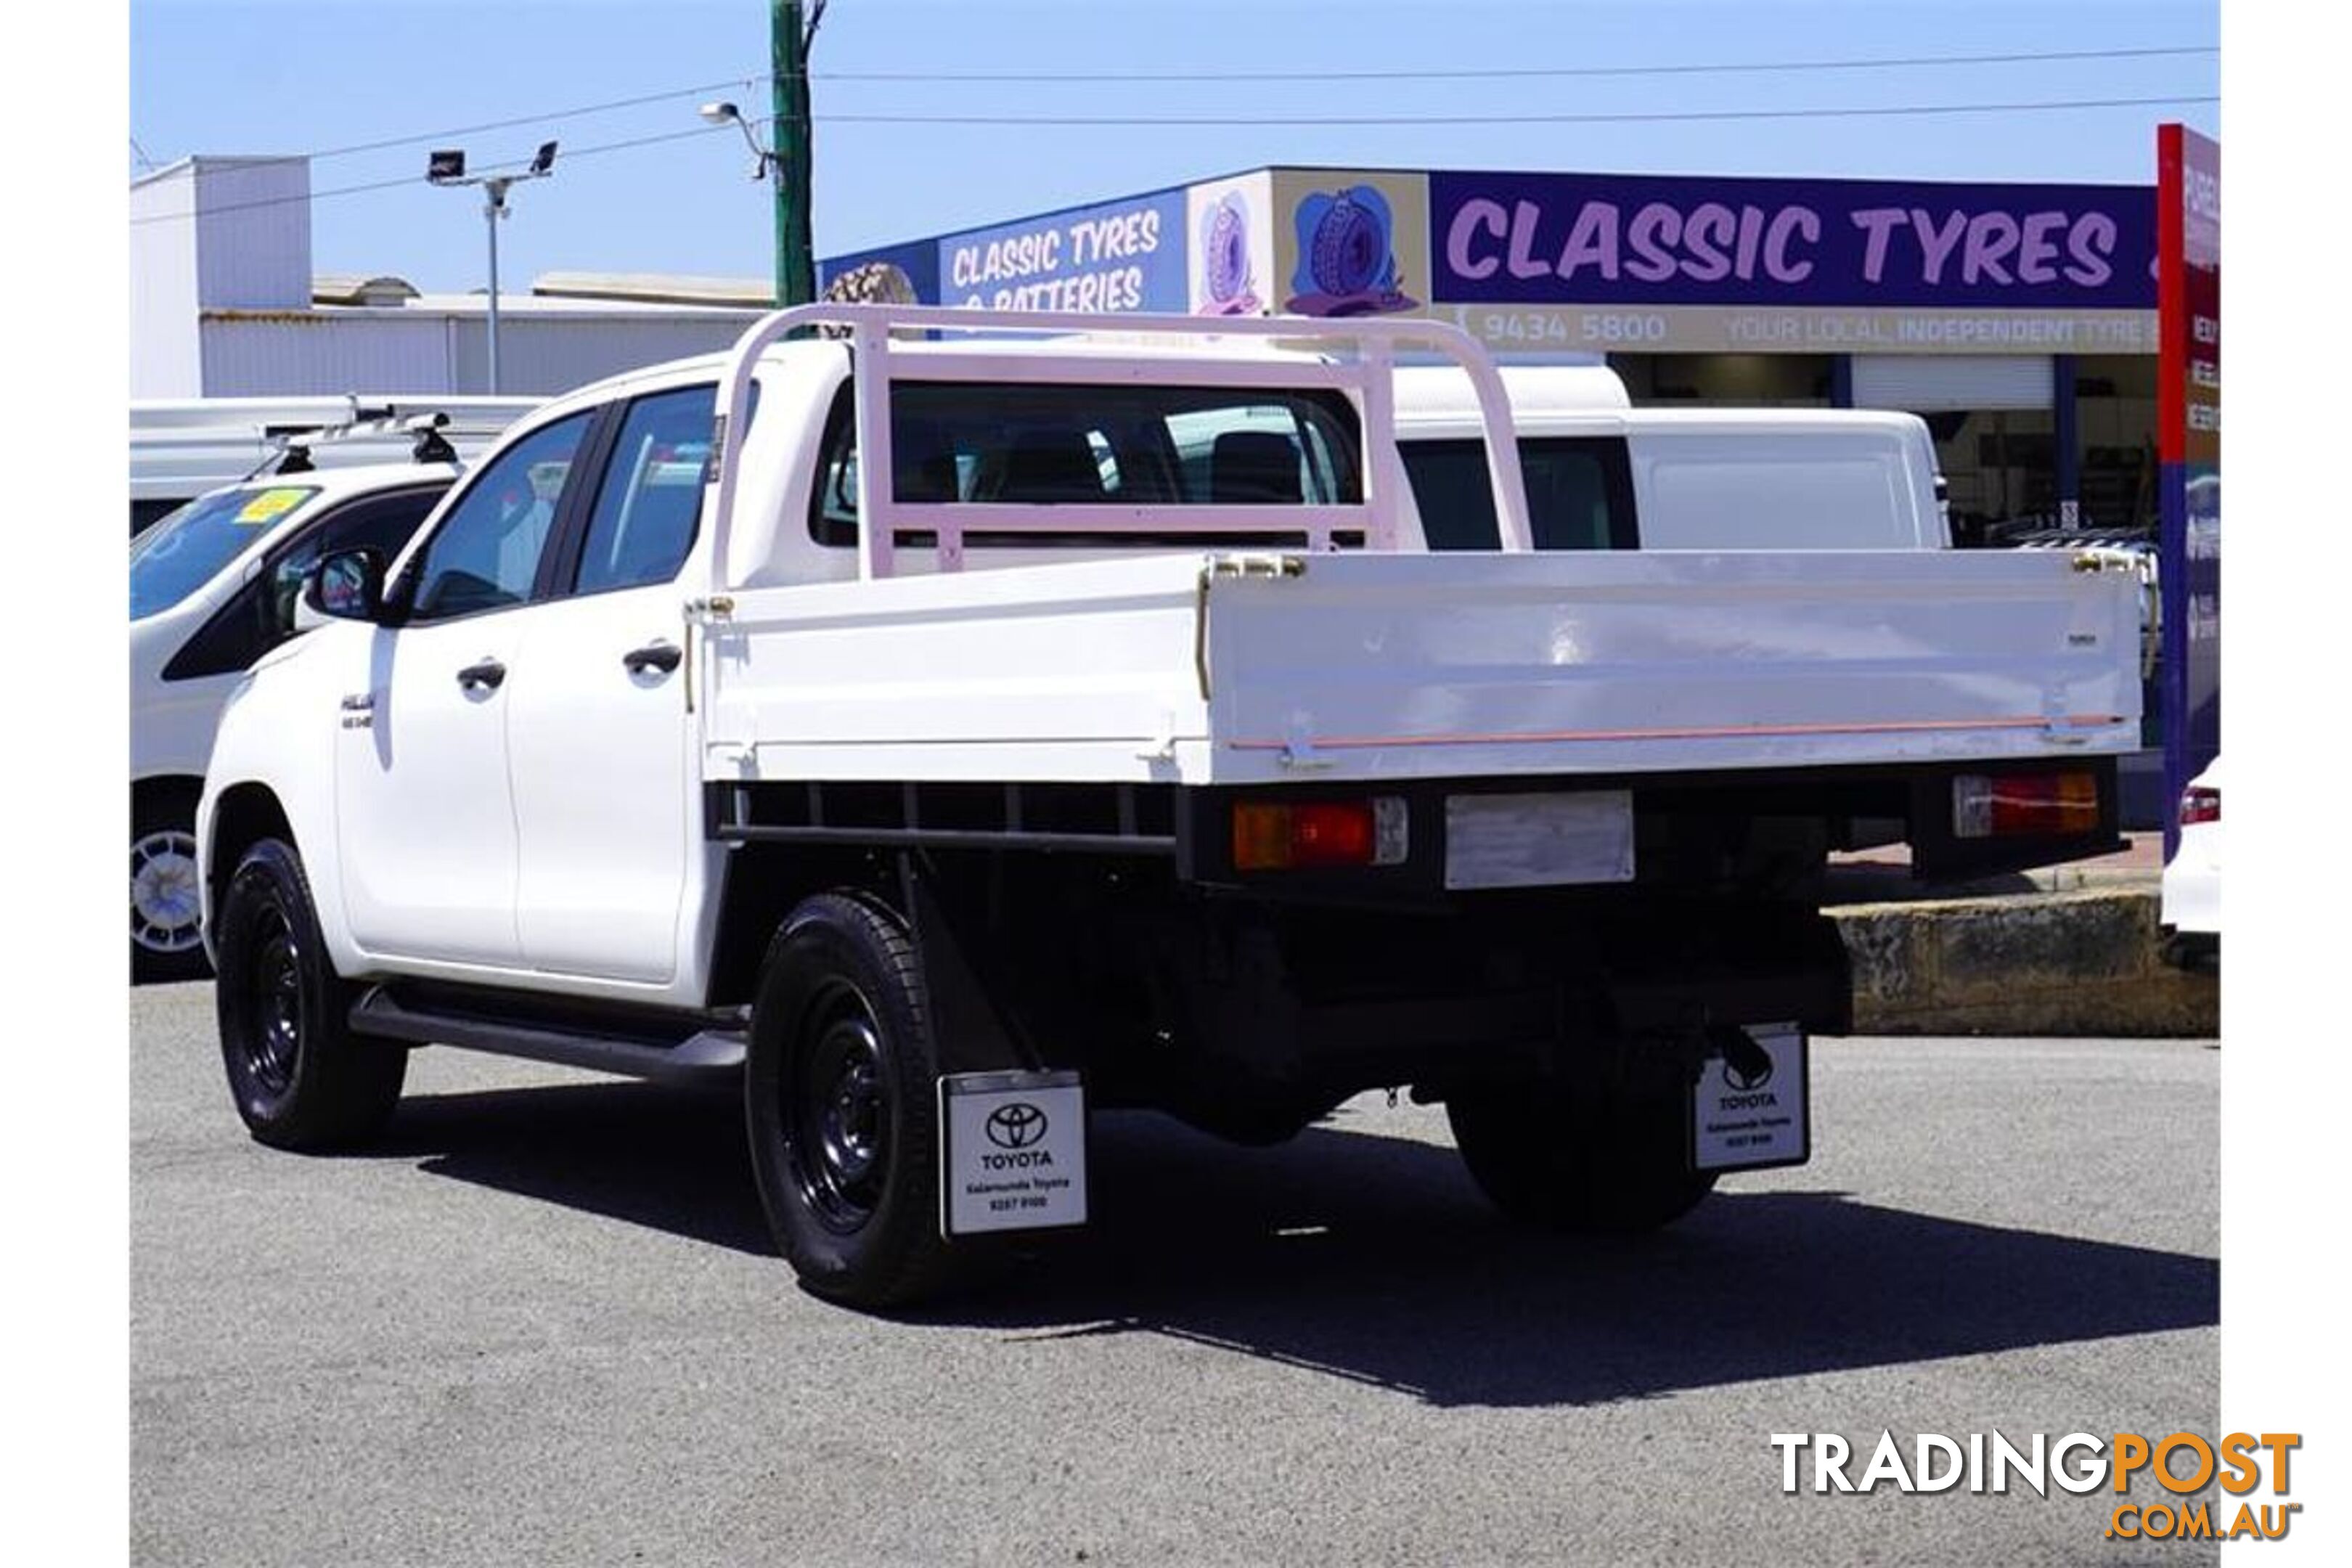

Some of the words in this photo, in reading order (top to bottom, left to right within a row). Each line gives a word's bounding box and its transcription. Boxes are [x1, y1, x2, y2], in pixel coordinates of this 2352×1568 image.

[952, 229, 1060, 287] CLASSIC
[1069, 209, 1160, 266] TYRES
[1447, 199, 1821, 282] CLASSIC
[1850, 208, 2117, 286] TYRES
[993, 266, 1143, 313] BATTERIES
[1485, 314, 1567, 342] 9434
[1581, 314, 1667, 342] 5800
[1725, 312, 1797, 341] YOUR
[1897, 315, 2074, 343] INDEPENDENT
[1719, 1093, 1778, 1111] TOYOTA
[981, 1150, 1053, 1170] TOYOTA
